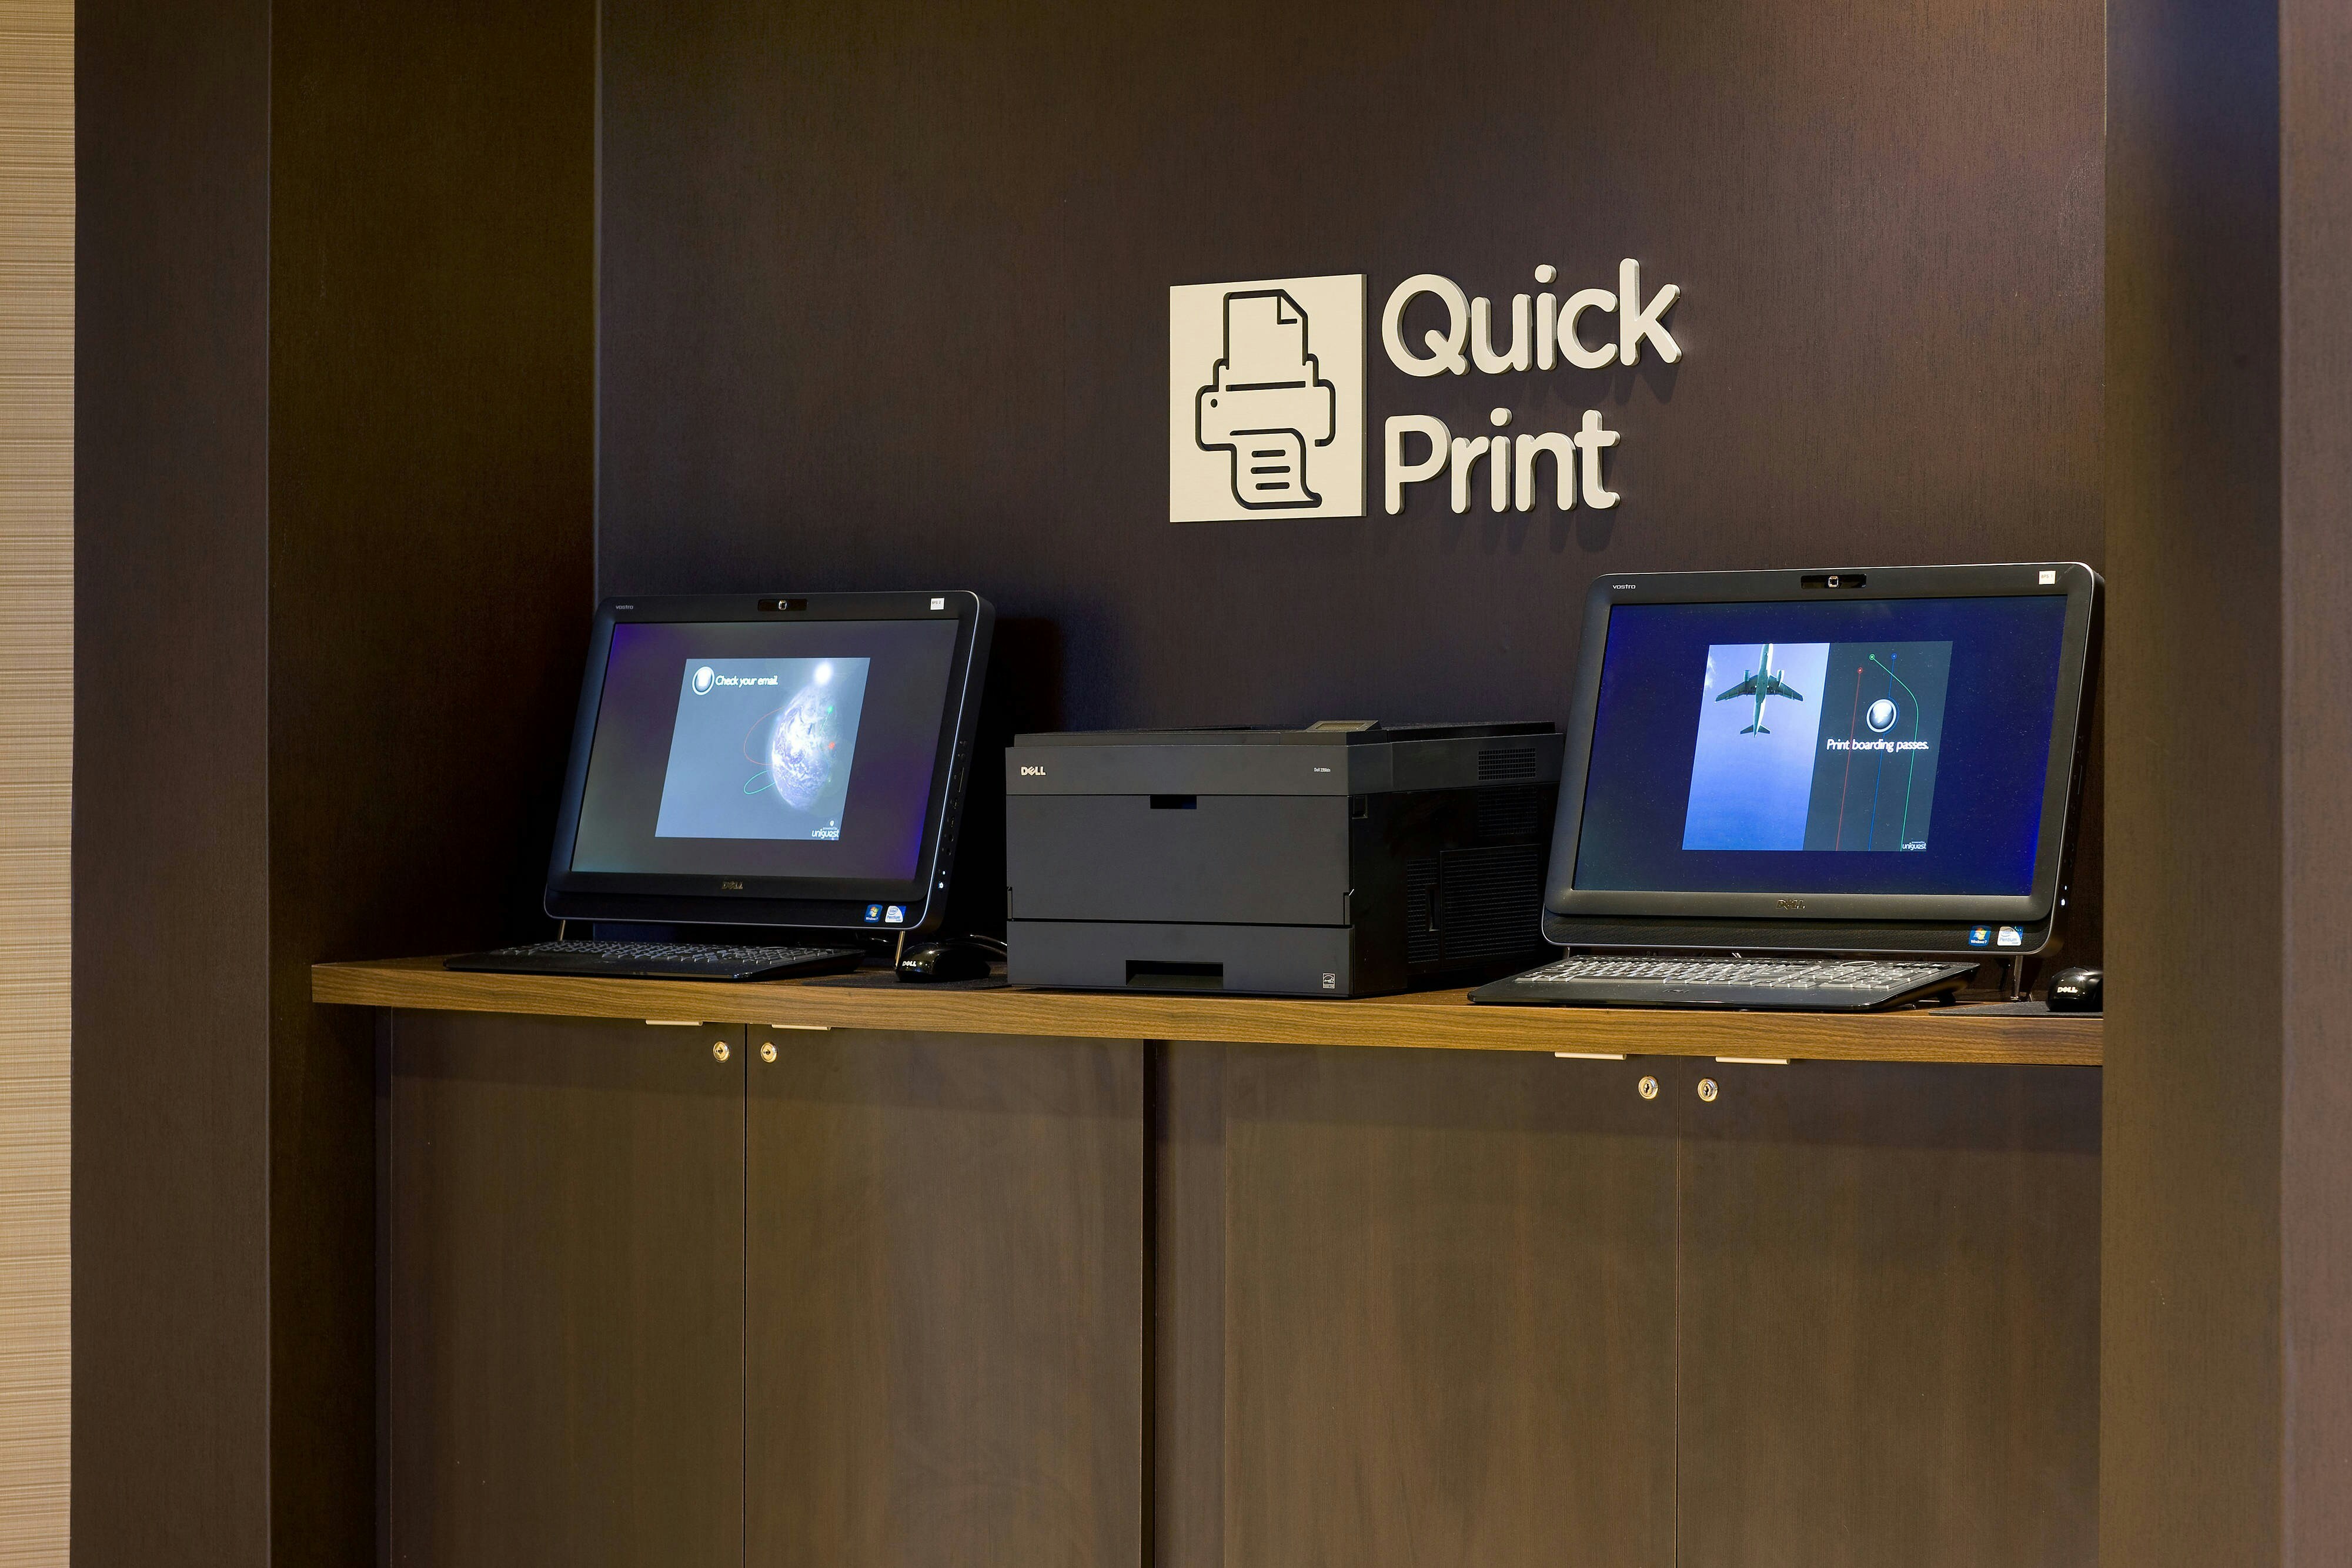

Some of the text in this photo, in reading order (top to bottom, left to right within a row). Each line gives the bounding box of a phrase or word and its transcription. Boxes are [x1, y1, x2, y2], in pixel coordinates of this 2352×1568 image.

[1382, 258, 1682, 377] Quick
[1385, 407, 1621, 515] Print
[715, 675, 779, 688] Check your email.
[1826, 738, 1929, 753] Print boarding passes.
[1021, 766, 1046, 776] DELL
[811, 828, 839, 839] uniguest
[1902, 842, 1927, 850] uniguest
[722, 881, 743, 890] DELL
[1776, 900, 1805, 910] DELL
